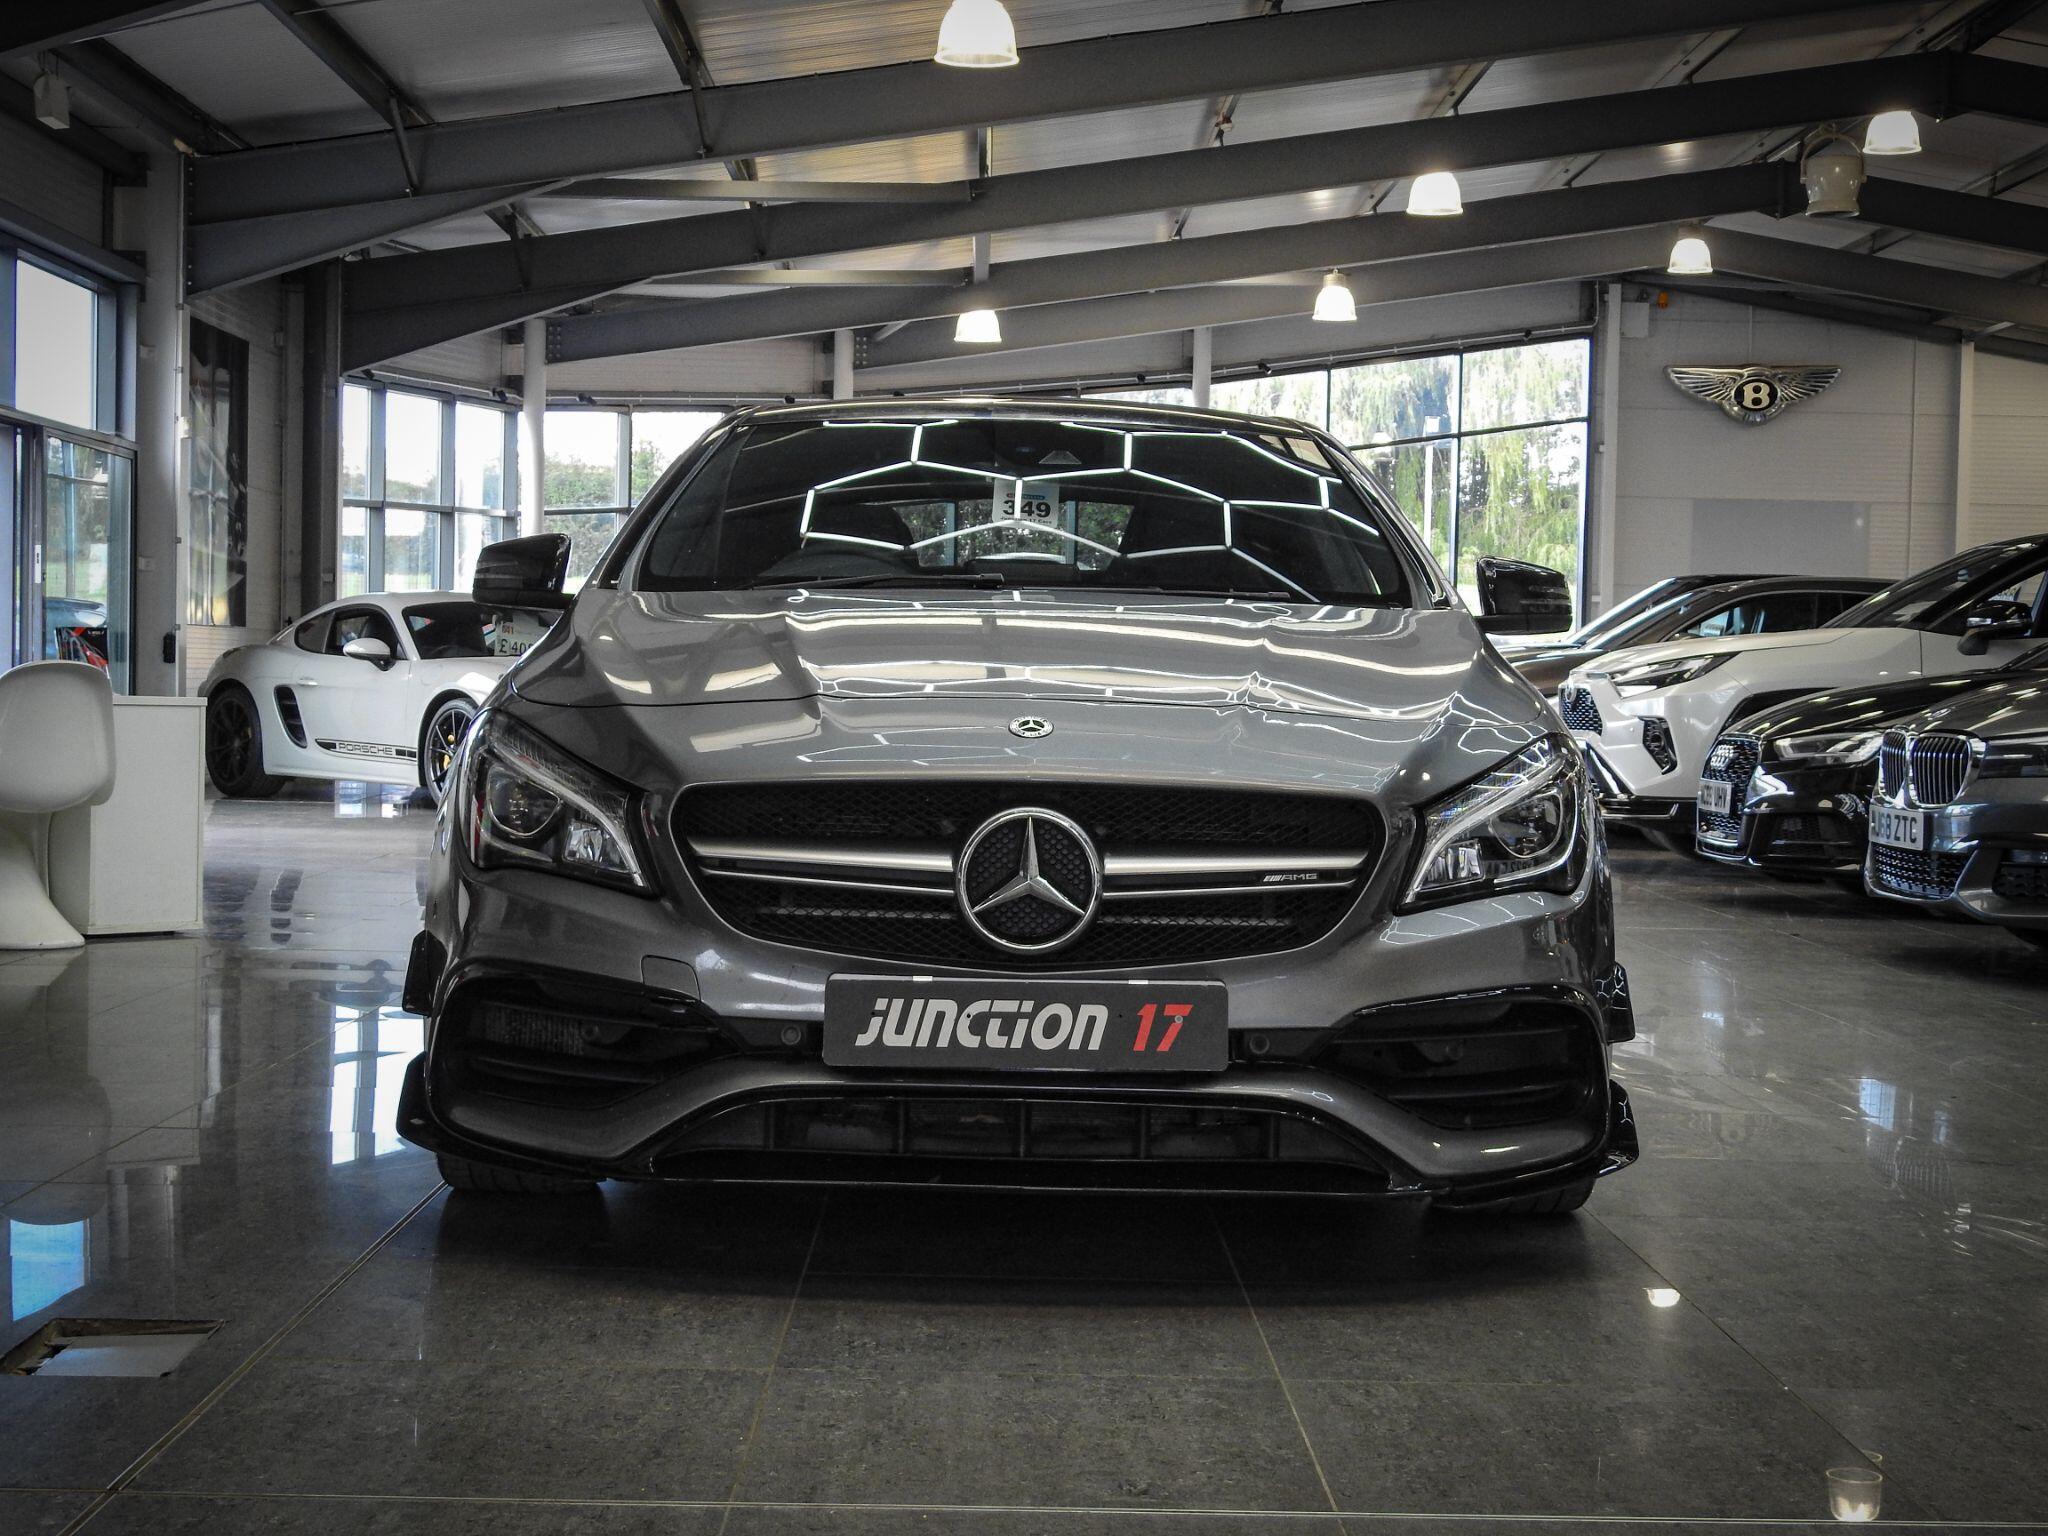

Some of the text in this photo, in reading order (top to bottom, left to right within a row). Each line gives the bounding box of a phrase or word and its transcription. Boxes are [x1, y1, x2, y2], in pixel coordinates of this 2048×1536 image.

[1743, 382, 1771, 409] B
[1003, 500, 1051, 518] 349
[339, 742, 393, 756] PORSCHE
[1893, 814, 1917, 843] ZTC
[1281, 873, 1317, 881] AMG
[1132, 1003, 1194, 1052] 17
